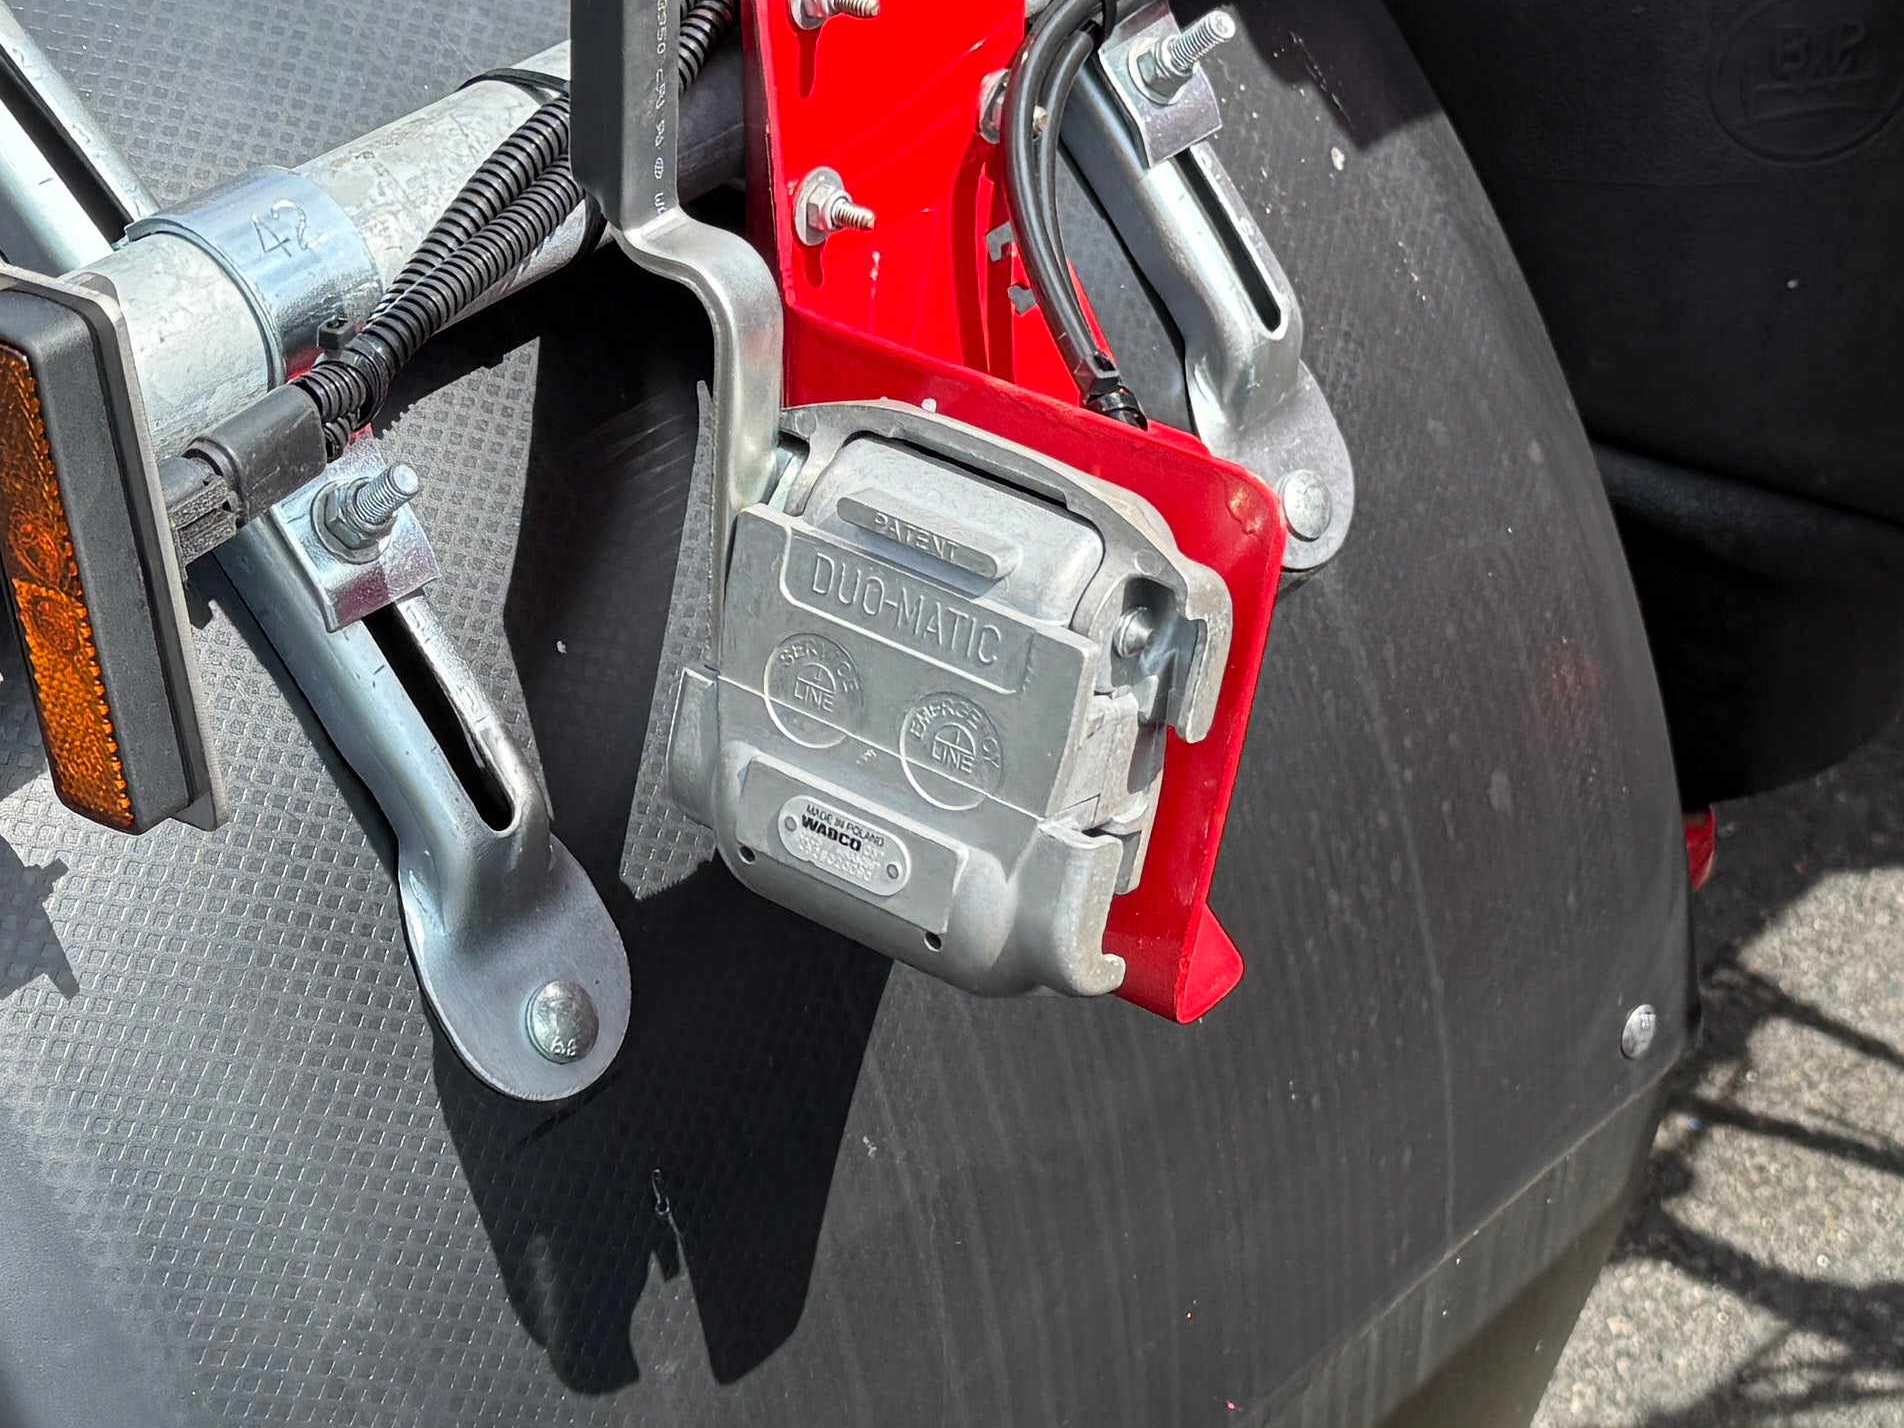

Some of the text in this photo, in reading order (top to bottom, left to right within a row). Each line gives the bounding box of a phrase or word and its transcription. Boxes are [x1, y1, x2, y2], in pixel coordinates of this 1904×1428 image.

[250, 197, 322, 260] 42
[874, 511, 962, 564] PATENT
[810, 551, 1004, 667] DUO-MATIC
[792, 680, 837, 714] LINE
[931, 741, 975, 776] LINE
[801, 813, 862, 852] WABCO
